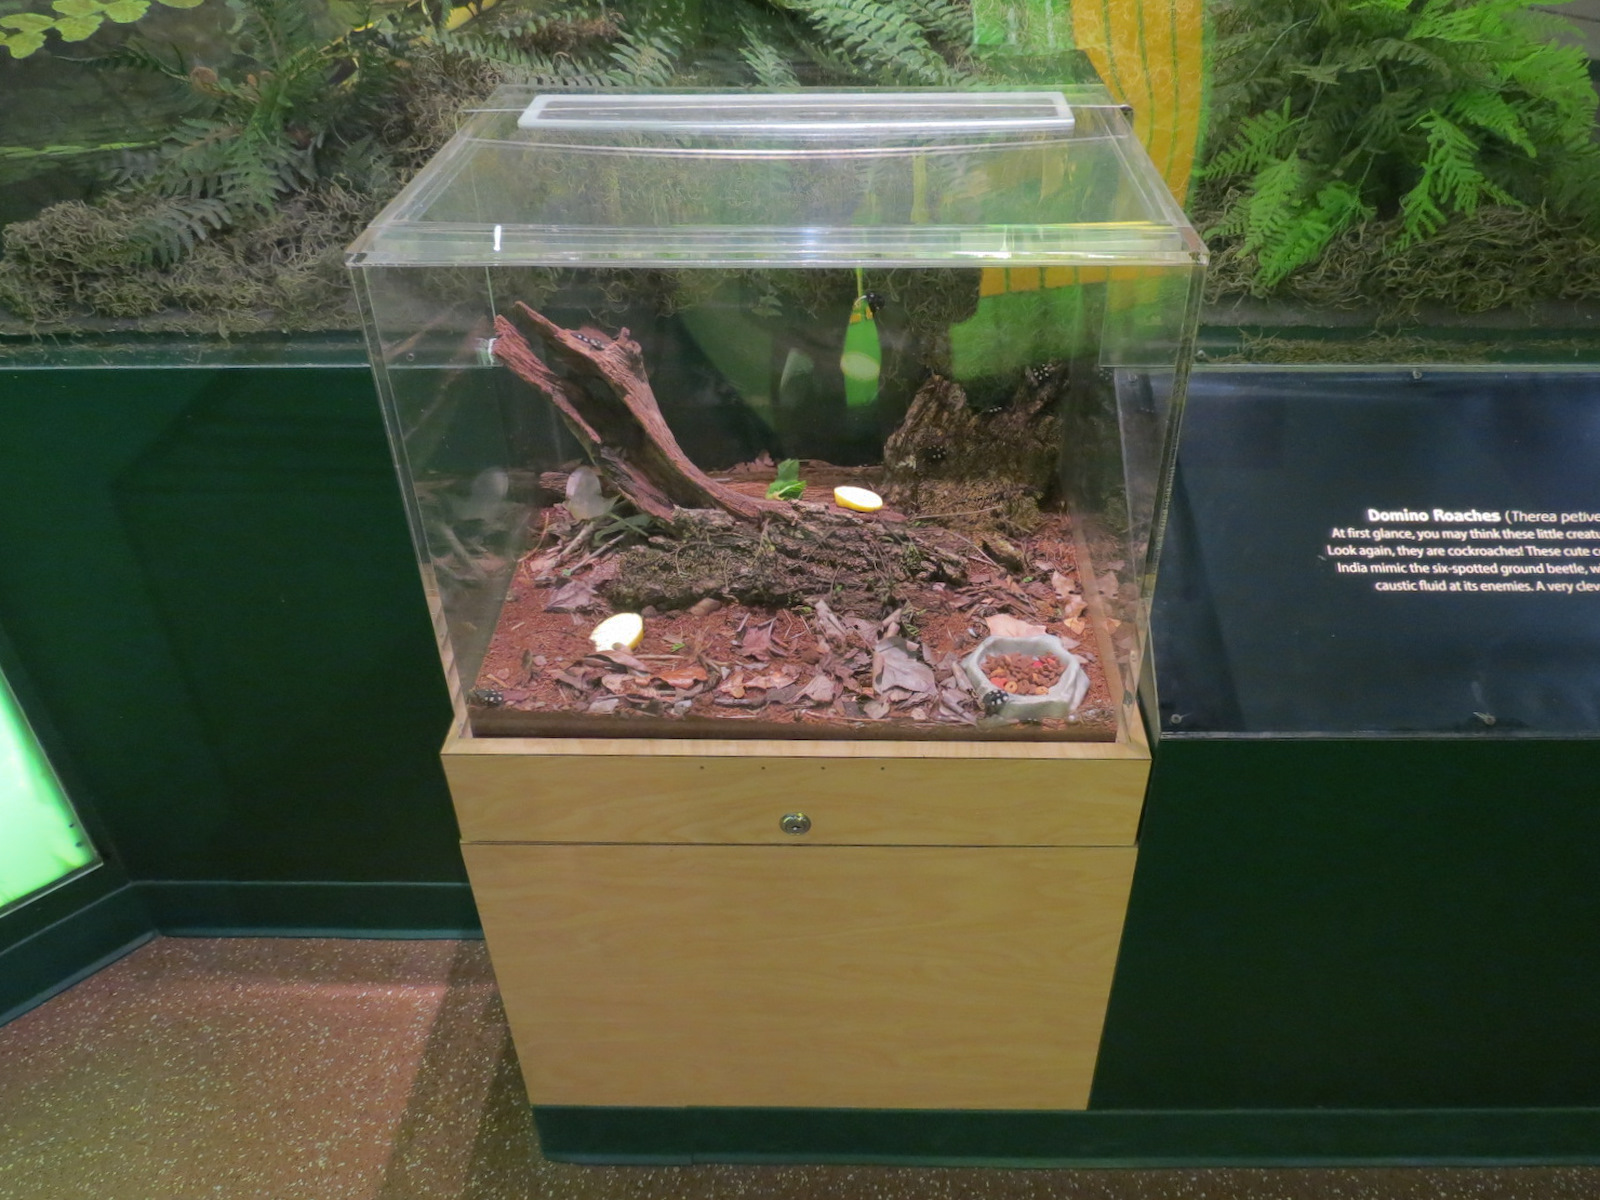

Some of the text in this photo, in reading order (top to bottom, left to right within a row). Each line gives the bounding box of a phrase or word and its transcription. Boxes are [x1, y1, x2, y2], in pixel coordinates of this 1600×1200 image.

[1367, 508, 1429, 522] Domino
[1433, 509, 1501, 522] Roaches
[1505, 510, 1557, 524] (Therea
[1331, 528, 1346, 539] At
[1347, 528, 1370, 539] first
[1373, 528, 1416, 541] glance,
[1417, 532, 1440, 541] you
[1442, 531, 1467, 541] may
[1469, 528, 1500, 539] think
[1502, 528, 1535, 539] these
[1536, 528, 1564, 539] little
[1327, 545, 1357, 556] Look
[1359, 545, 1395, 558] again,
[1397, 545, 1424, 558] they
[1426, 548, 1446, 556] are
[1448, 545, 1525, 557] cockroaches!
[1525, 545, 1561, 556] These
[1563, 547, 1591, 557] cute
[1337, 563, 1368, 573] India
[1370, 562, 1408, 573] mimic
[1409, 562, 1431, 573] the
[1432, 562, 1499, 575] six-spotted
[1500, 563, 1545, 576] ground
[1546, 563, 1589, 575] beetle,
[1375, 581, 1418, 591] caustic
[1419, 580, 1447, 591] fluid
[1449, 582, 1461, 591] at
[1463, 581, 1478, 591] its
[1480, 581, 1534, 592] enemies.
[1536, 581, 1546, 591] A
[1547, 583, 1574, 594] very
